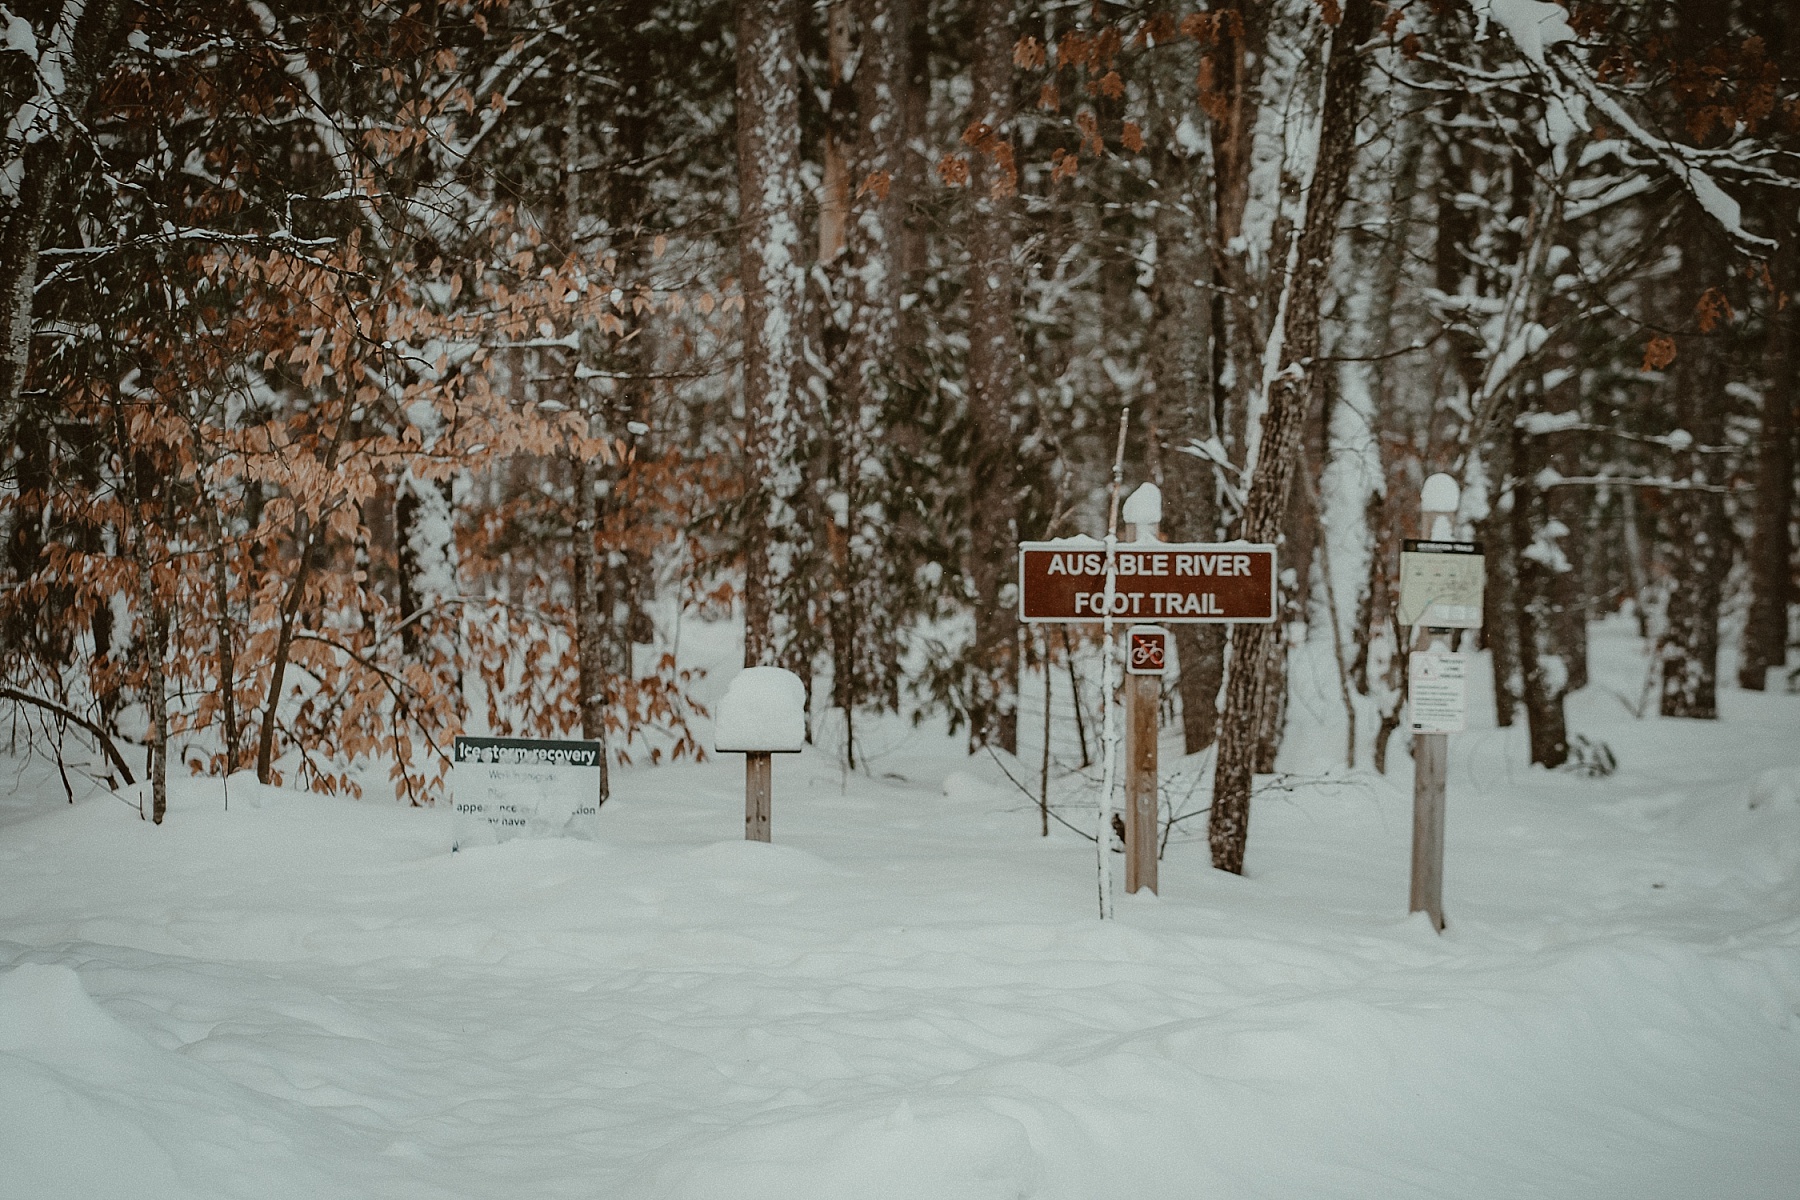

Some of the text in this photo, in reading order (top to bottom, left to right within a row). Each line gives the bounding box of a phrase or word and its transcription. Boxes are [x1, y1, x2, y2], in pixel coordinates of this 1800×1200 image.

[1047, 554, 1252, 577] AUSABLE RIVER
[1075, 592, 1224, 615] FOOT TRAIL
[482, 744, 528, 761] torm
[532, 748, 596, 766] recovery
